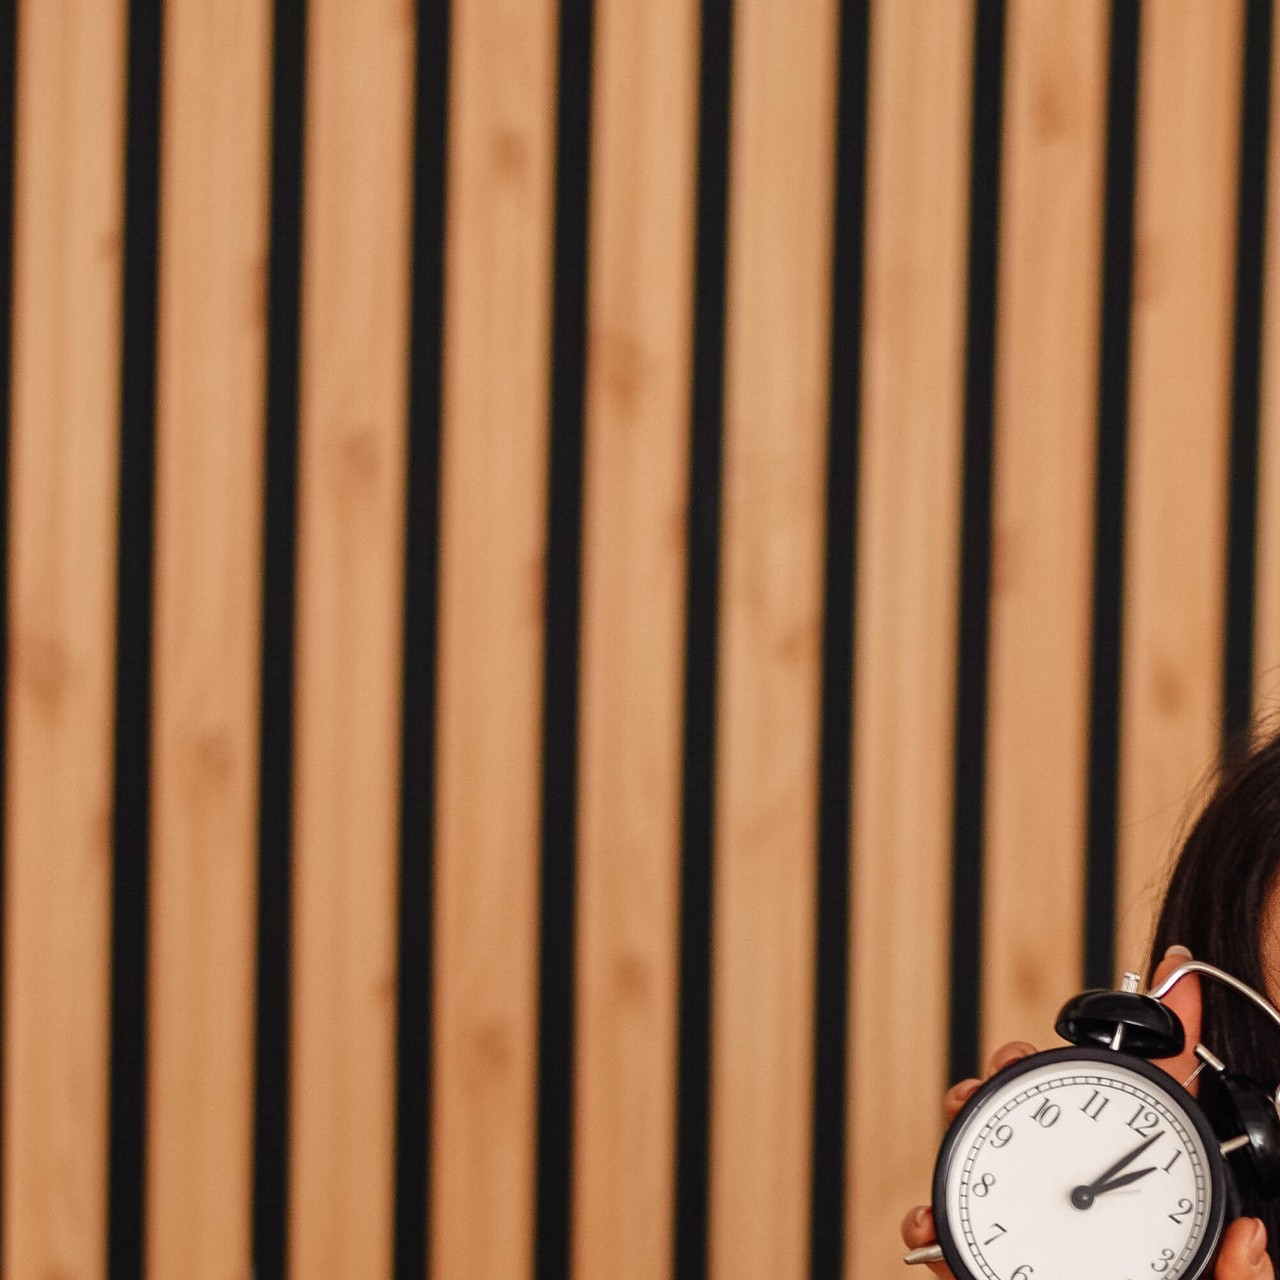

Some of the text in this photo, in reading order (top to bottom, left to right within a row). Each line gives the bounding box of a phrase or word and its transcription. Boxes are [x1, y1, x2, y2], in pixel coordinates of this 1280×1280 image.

[1030, 1098, 1061, 1128] 10
[1079, 1090, 1110, 1121] 11
[1126, 1104, 1159, 1137] 12
[989, 1124, 1013, 1148] 9
[1161, 1149, 1181, 1174] 1
[972, 1173, 996, 1197] 8
[1168, 1198, 1193, 1224] 2
[983, 1223, 1008, 1245] 7
[1150, 1248, 1174, 1274] 3
